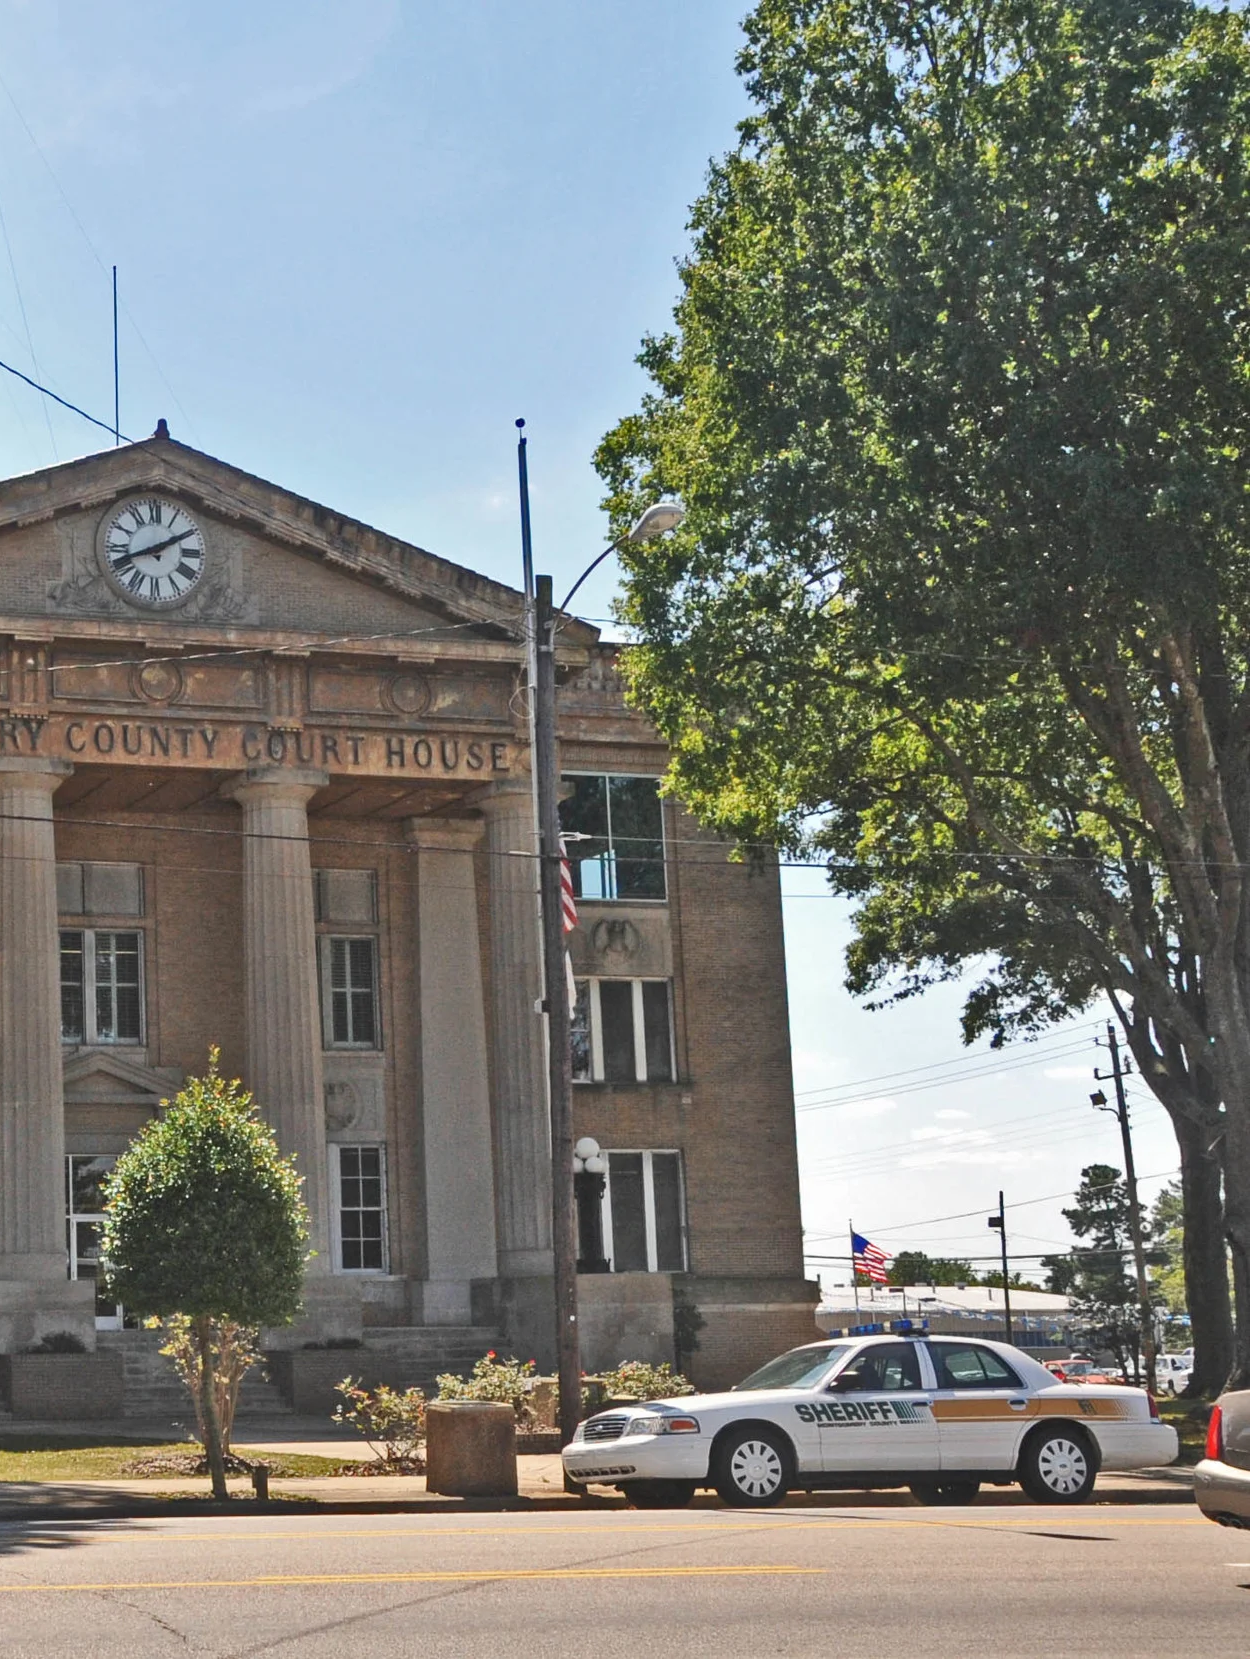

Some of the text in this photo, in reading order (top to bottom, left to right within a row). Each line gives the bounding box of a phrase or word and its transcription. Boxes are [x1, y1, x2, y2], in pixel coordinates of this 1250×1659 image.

[66, 722, 219, 759] COUNTY
[242, 728, 365, 765] COURT
[386, 737, 511, 772] HOUSE
[794, 1401, 893, 1423] SHERIFF
